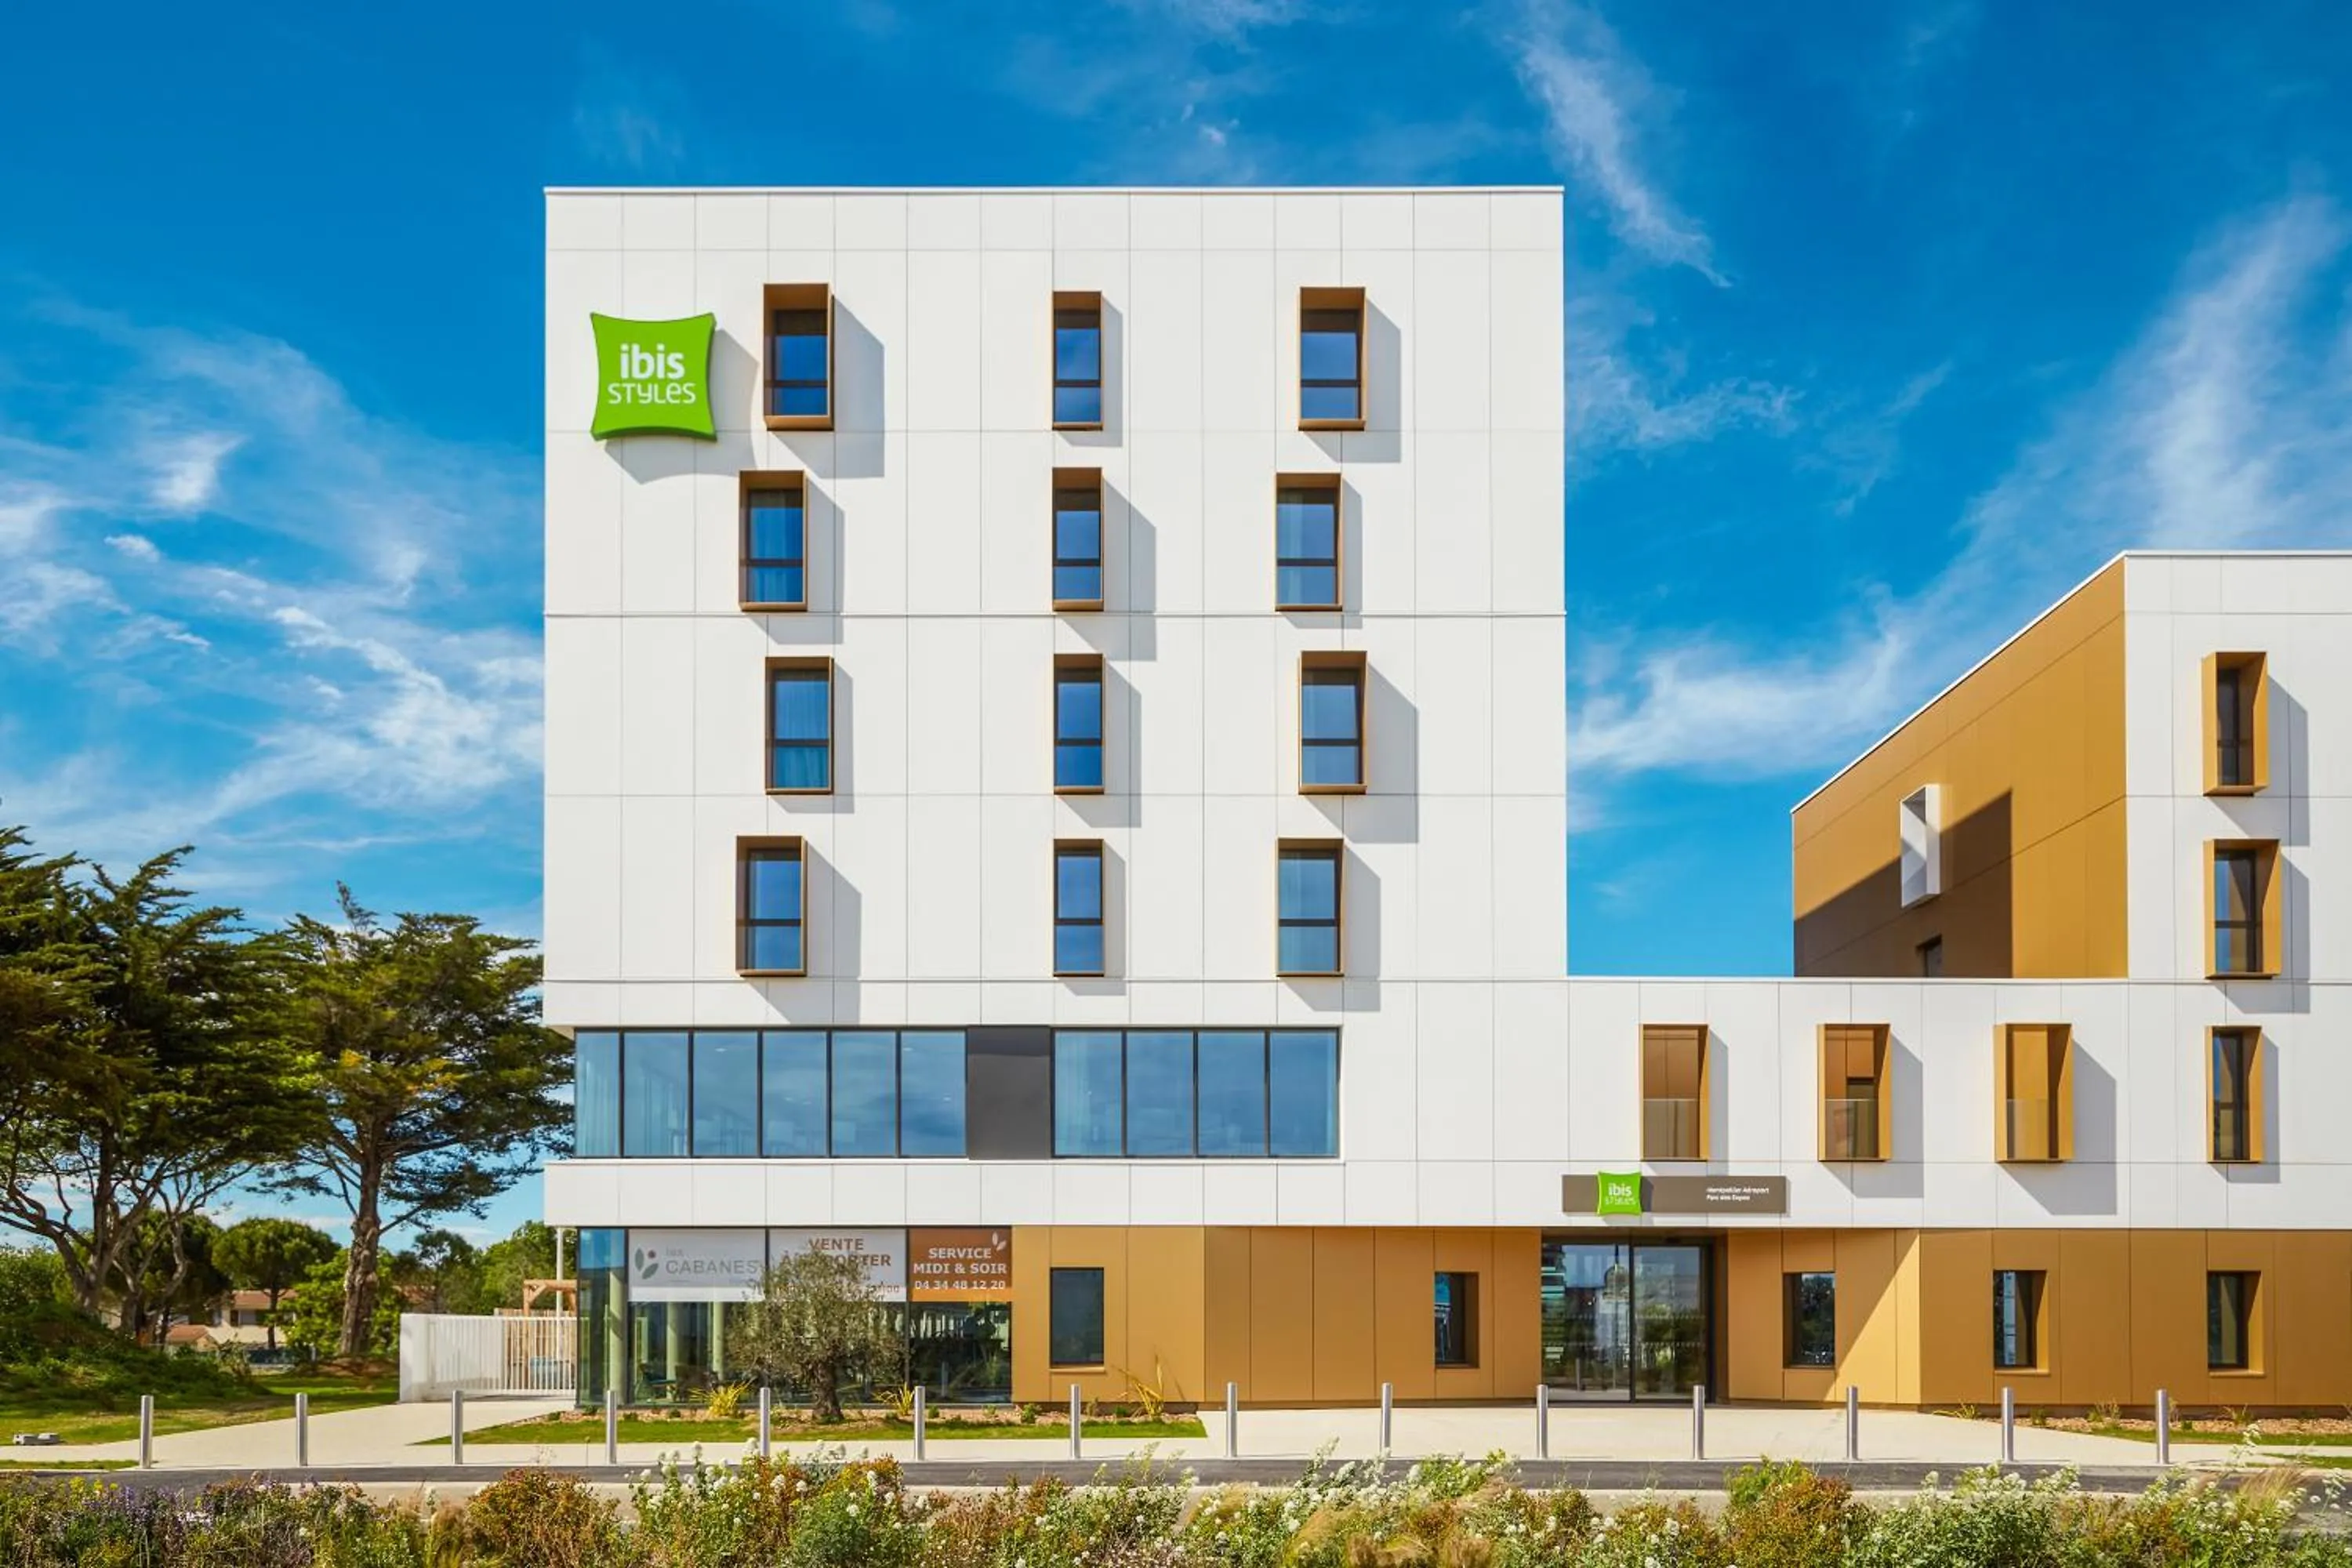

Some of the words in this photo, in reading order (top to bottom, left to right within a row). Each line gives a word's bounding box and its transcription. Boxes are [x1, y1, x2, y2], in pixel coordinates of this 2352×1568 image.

[620, 343, 685, 379] ibis
[1608, 1182, 1632, 1196] ibis
[808, 1238, 865, 1251] VENTE
[928, 1247, 992, 1259] SERVICE
[665, 1259, 760, 1275] CABANES
[913, 1263, 950, 1274] MIDI
[954, 1263, 966, 1274] &
[970, 1263, 1007, 1274] SOIR
[914, 1280, 929, 1290] 04
[933, 1280, 948, 1290] 34
[972, 1280, 987, 1290] 12
[990, 1280, 1006, 1290] 20
